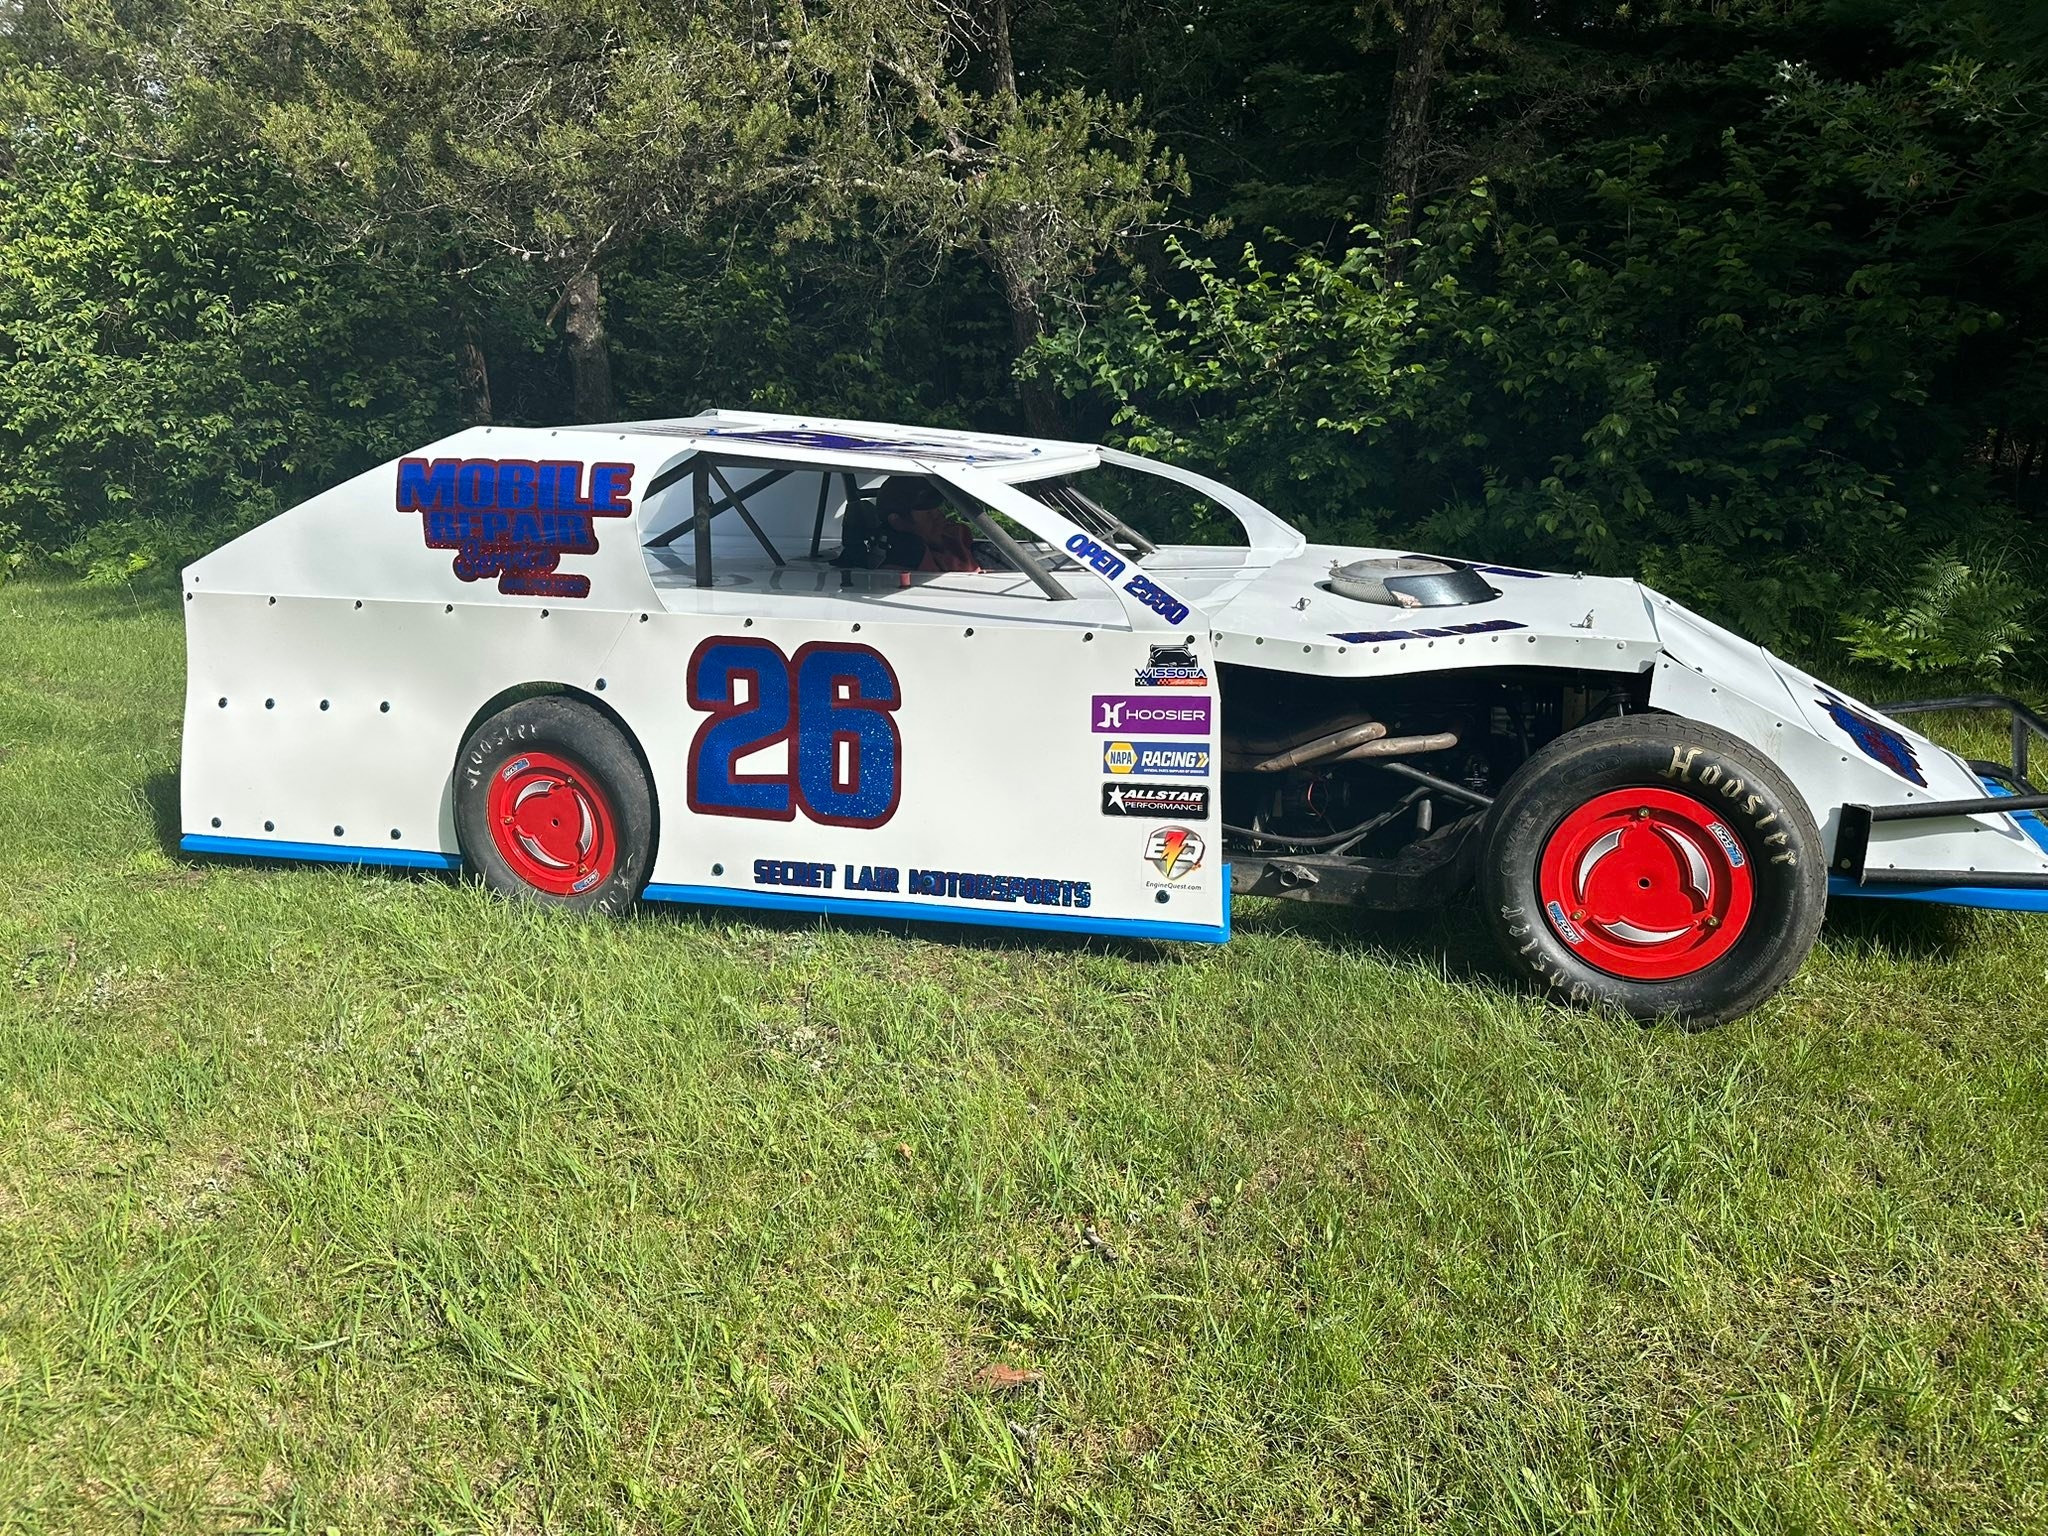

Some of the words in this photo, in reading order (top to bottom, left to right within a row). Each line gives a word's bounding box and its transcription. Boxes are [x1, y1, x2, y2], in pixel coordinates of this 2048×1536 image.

[398, 460, 633, 516] MOBILE
[427, 511, 593, 547] REPAIR
[1065, 533, 1126, 581] OPEN
[1122, 574, 1190, 625] 2550
[1134, 668, 1207, 677] WISSOTA
[1125, 709, 1206, 721] HOOSIER
[687, 635, 901, 829] 26
[1109, 751, 1133, 765] NAPA
[1141, 750, 1197, 768] RACING
[1123, 789, 1205, 802] ALLSTAR
[1124, 801, 1204, 812] PERFORMANCE
[753, 859, 837, 889] SECRET
[844, 864, 900, 893] LAIR
[908, 868, 1092, 909] MOTORSPORTS
[1146, 881, 1202, 891] EngineQuest.com
